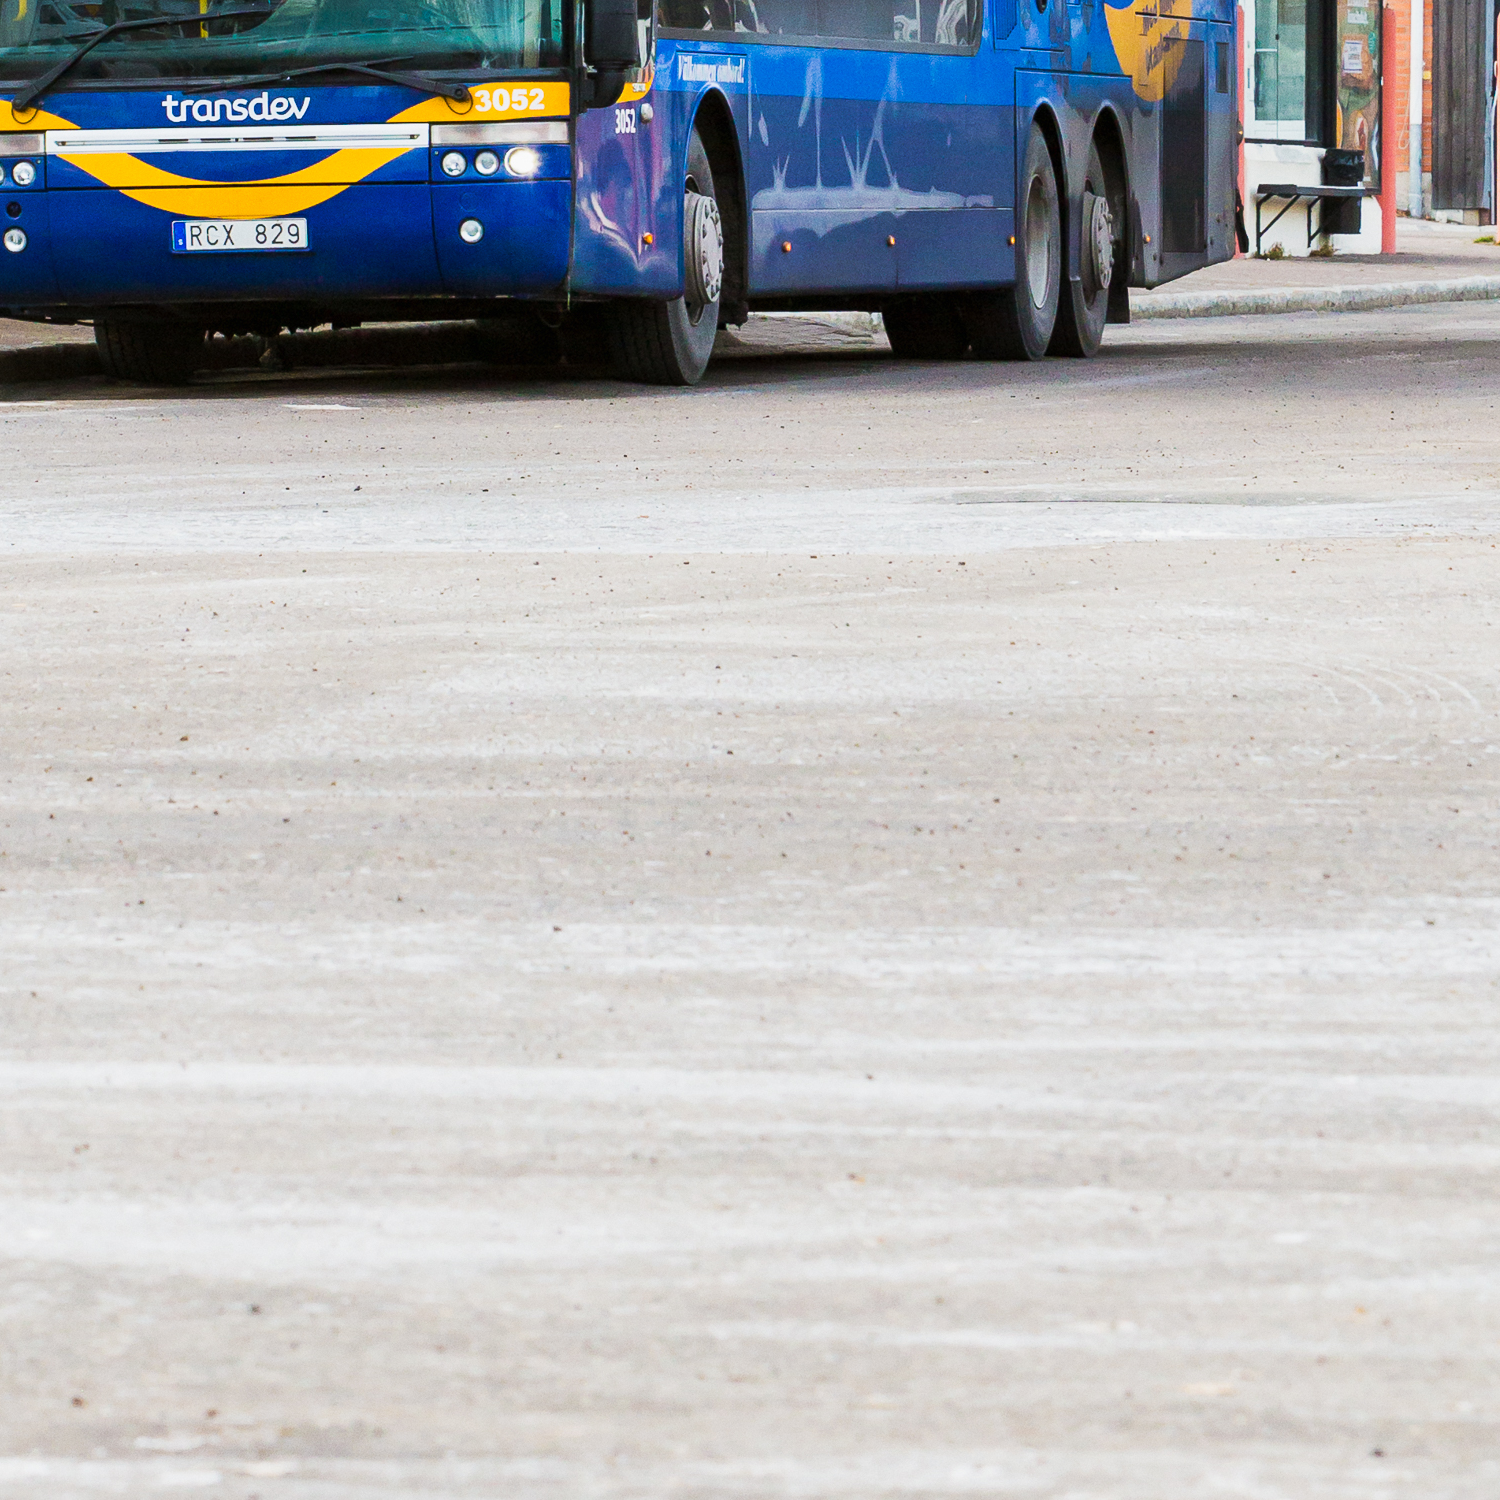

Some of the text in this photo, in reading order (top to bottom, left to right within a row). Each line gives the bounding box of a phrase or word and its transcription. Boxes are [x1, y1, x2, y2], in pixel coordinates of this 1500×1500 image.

[161, 92, 311, 123] transdev
[474, 88, 545, 113] 3052
[615, 108, 637, 134] 3052
[190, 224, 235, 247] RCX
[255, 223, 301, 244] 829
